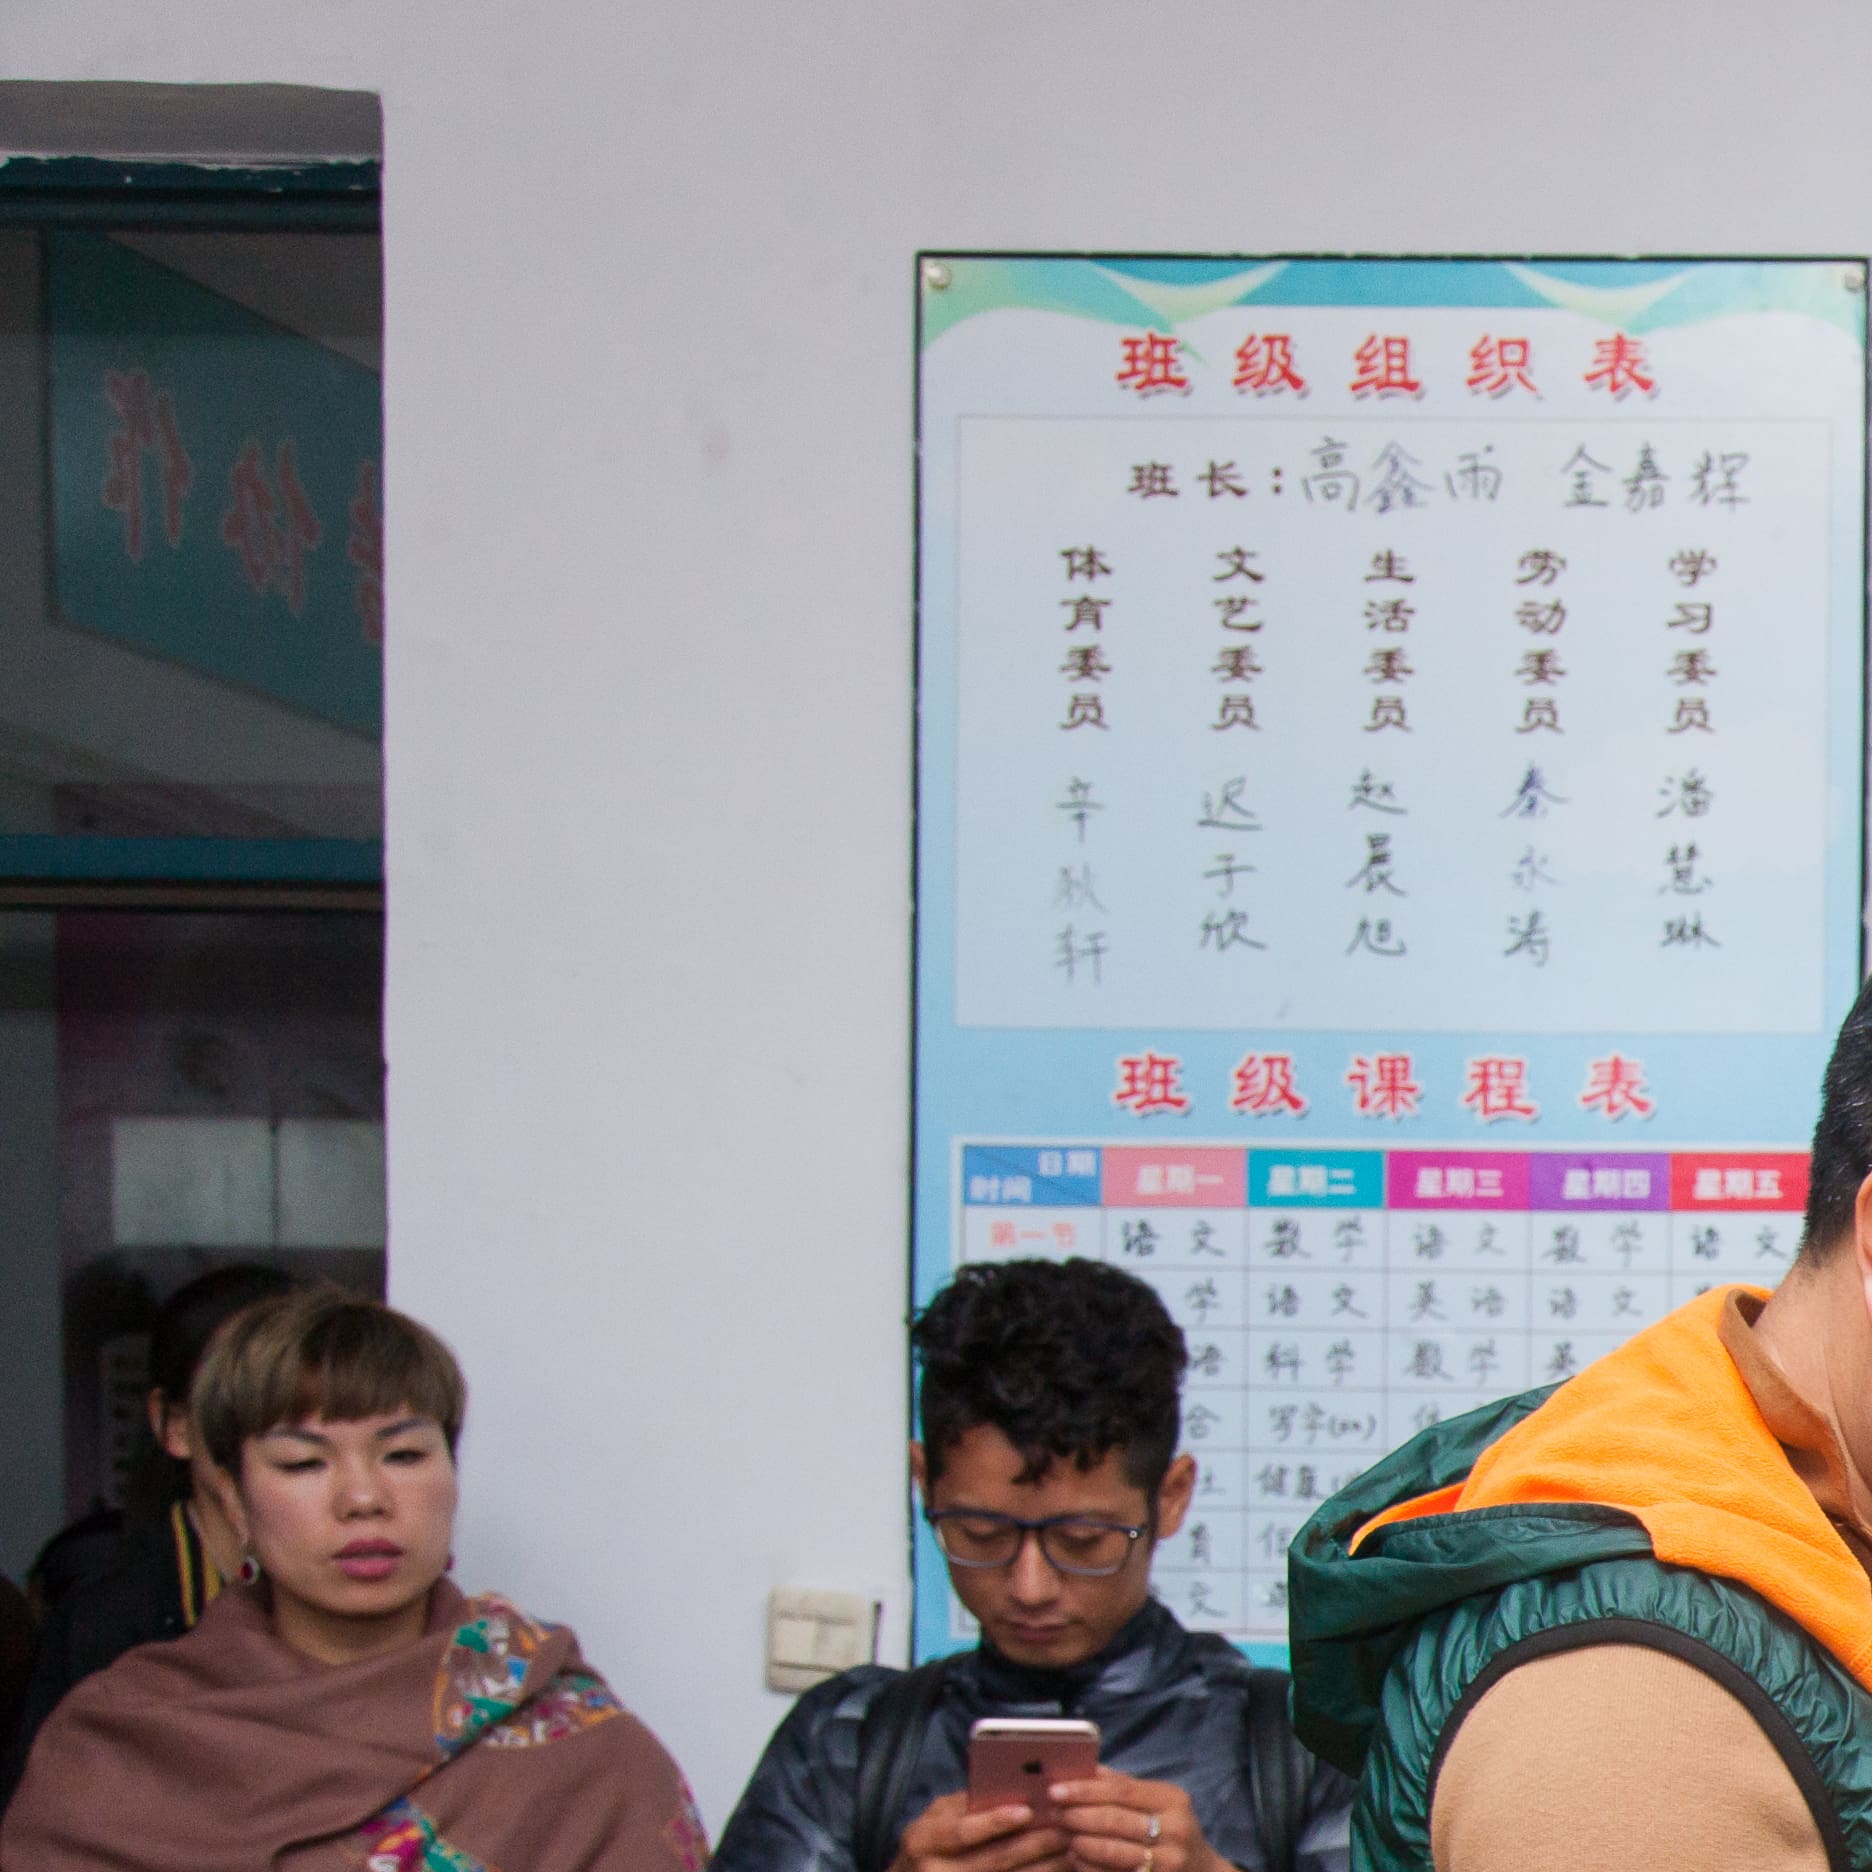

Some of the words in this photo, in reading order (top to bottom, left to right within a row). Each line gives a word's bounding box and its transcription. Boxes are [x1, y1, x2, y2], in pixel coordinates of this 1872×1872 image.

[1116, 332, 1657, 396] 班级组织表
[1560, 443, 1751, 511] 金嘉辉
[1058, 546, 1112, 732] 体育委员
[1211, 546, 1265, 732] 文艺委员
[1363, 547, 1416, 734] 生活委员
[1515, 548, 1568, 735] 劳动委员
[1664, 548, 1718, 735] 学习委员
[1115, 1052, 1657, 1119] 班级课程表
[1137, 1164, 1224, 1195] 星期一
[1267, 1164, 1357, 1198] 星期二
[1415, 1166, 1504, 1199] 星期三
[1563, 1168, 1651, 1200] 星期四
[1693, 1168, 1783, 1200] 星期五
[990, 1221, 1076, 1248] 第一节
[1121, 1218, 1226, 1257] 语文
[1264, 1215, 1367, 1263] 数学
[1412, 1222, 1506, 1260] 语文
[1542, 1219, 1643, 1268] 数学
[1691, 1223, 1788, 1260] 语文
[1184, 1277, 1221, 1323] 学
[1267, 1283, 1368, 1319] 语文
[1550, 1286, 1643, 1319] 语文
[1189, 1343, 1225, 1376] 语
[1265, 1340, 1354, 1385] 科学
[1185, 1404, 1222, 1440] 合
